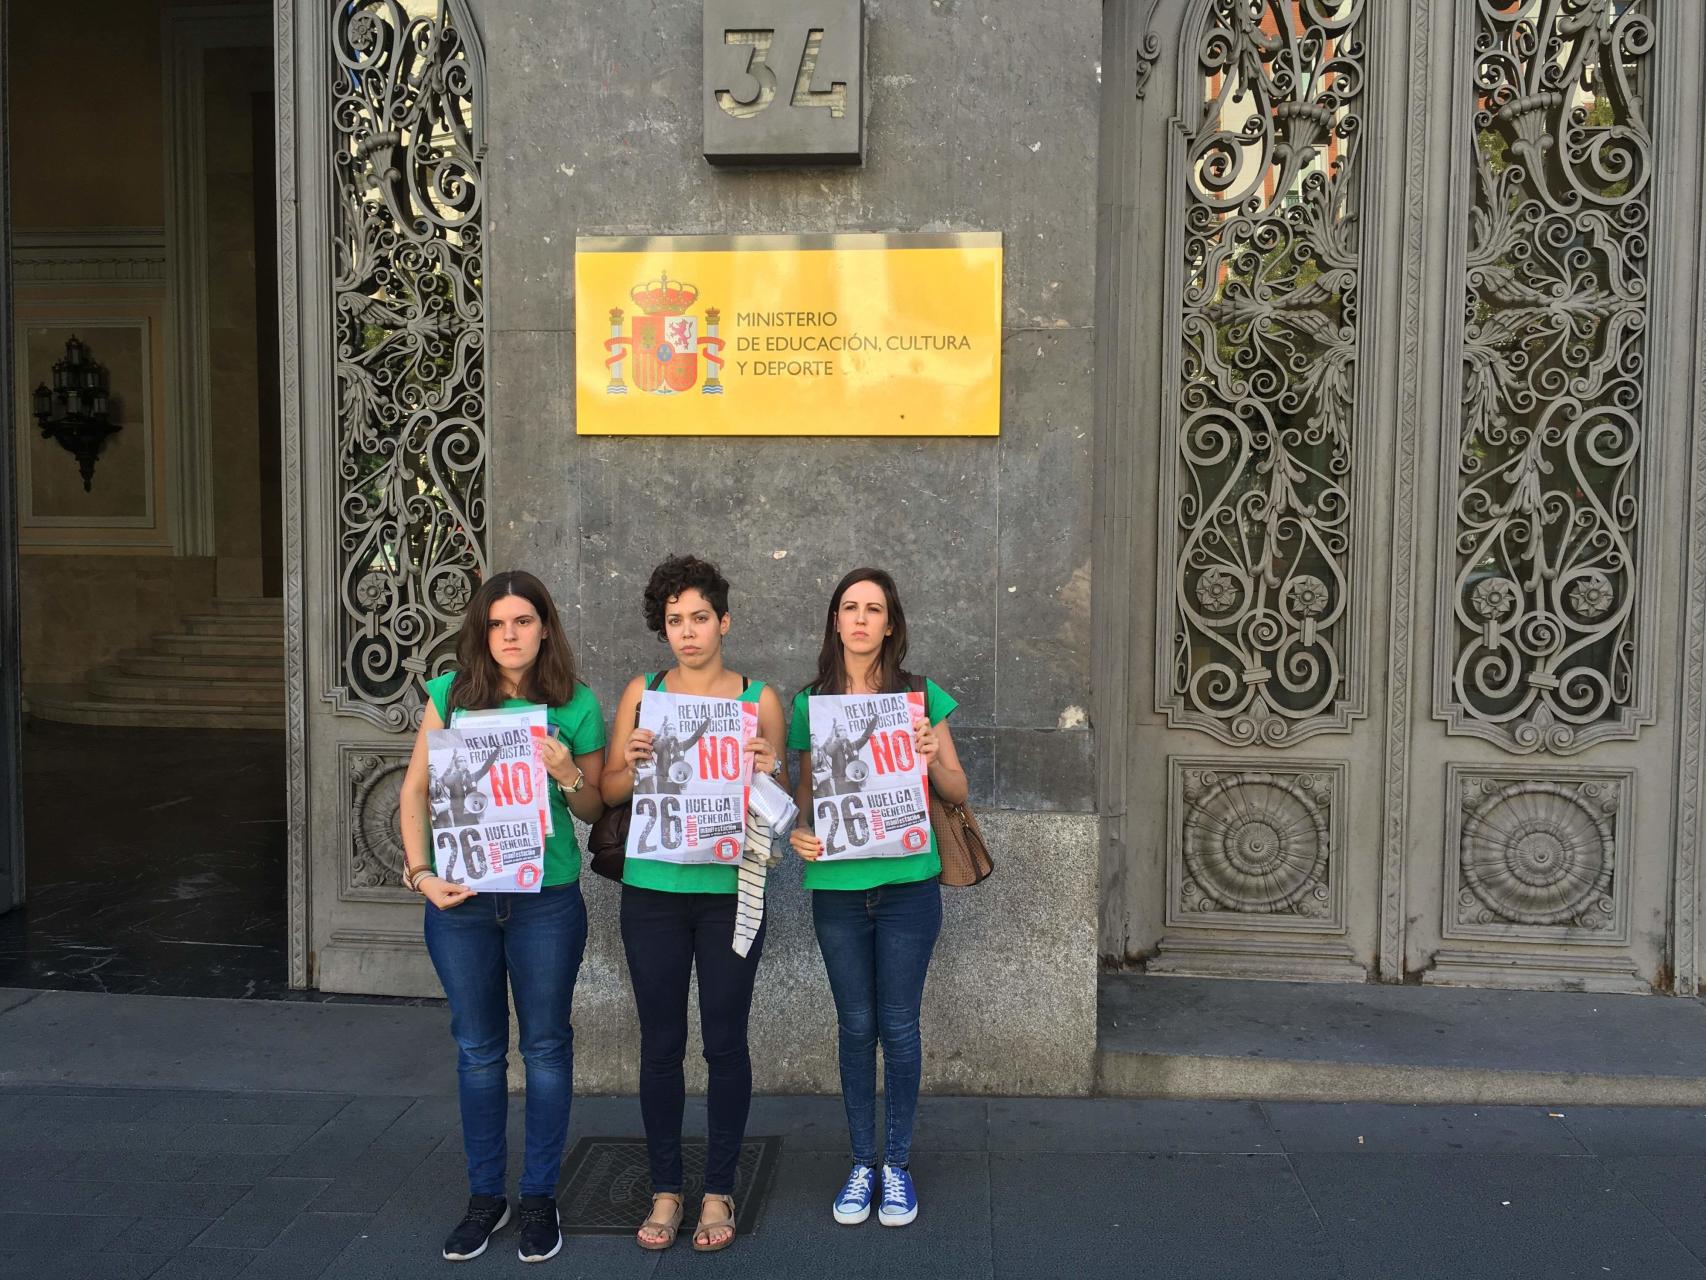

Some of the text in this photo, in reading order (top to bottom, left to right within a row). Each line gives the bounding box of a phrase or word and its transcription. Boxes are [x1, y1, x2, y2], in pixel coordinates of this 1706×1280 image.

[714, 28, 847, 119] 34
[736, 311, 838, 328] MINISTERIO
[736, 333, 972, 353] DE EDUCACIÓN, CULTURA
[736, 361, 834, 376] Y DEPORTE
[679, 718, 741, 733] FRANUISTAS
[848, 711, 909, 732] FRANUISTAS
[469, 744, 532, 764] FRANUISTAS
[698, 735, 741, 780] NO
[869, 729, 915, 775] NO
[489, 761, 534, 807] NO
[685, 797, 731, 813] HUELGA
[866, 788, 913, 808] HUELGA
[697, 812, 734, 825] GENERAL
[880, 803, 917, 818] GENERAL
[484, 822, 529, 841] HUELGA
[635, 796, 682, 855] 26
[817, 795, 870, 857] 26
[500, 837, 533, 851] GENERAL
[437, 827, 489, 884] 26
